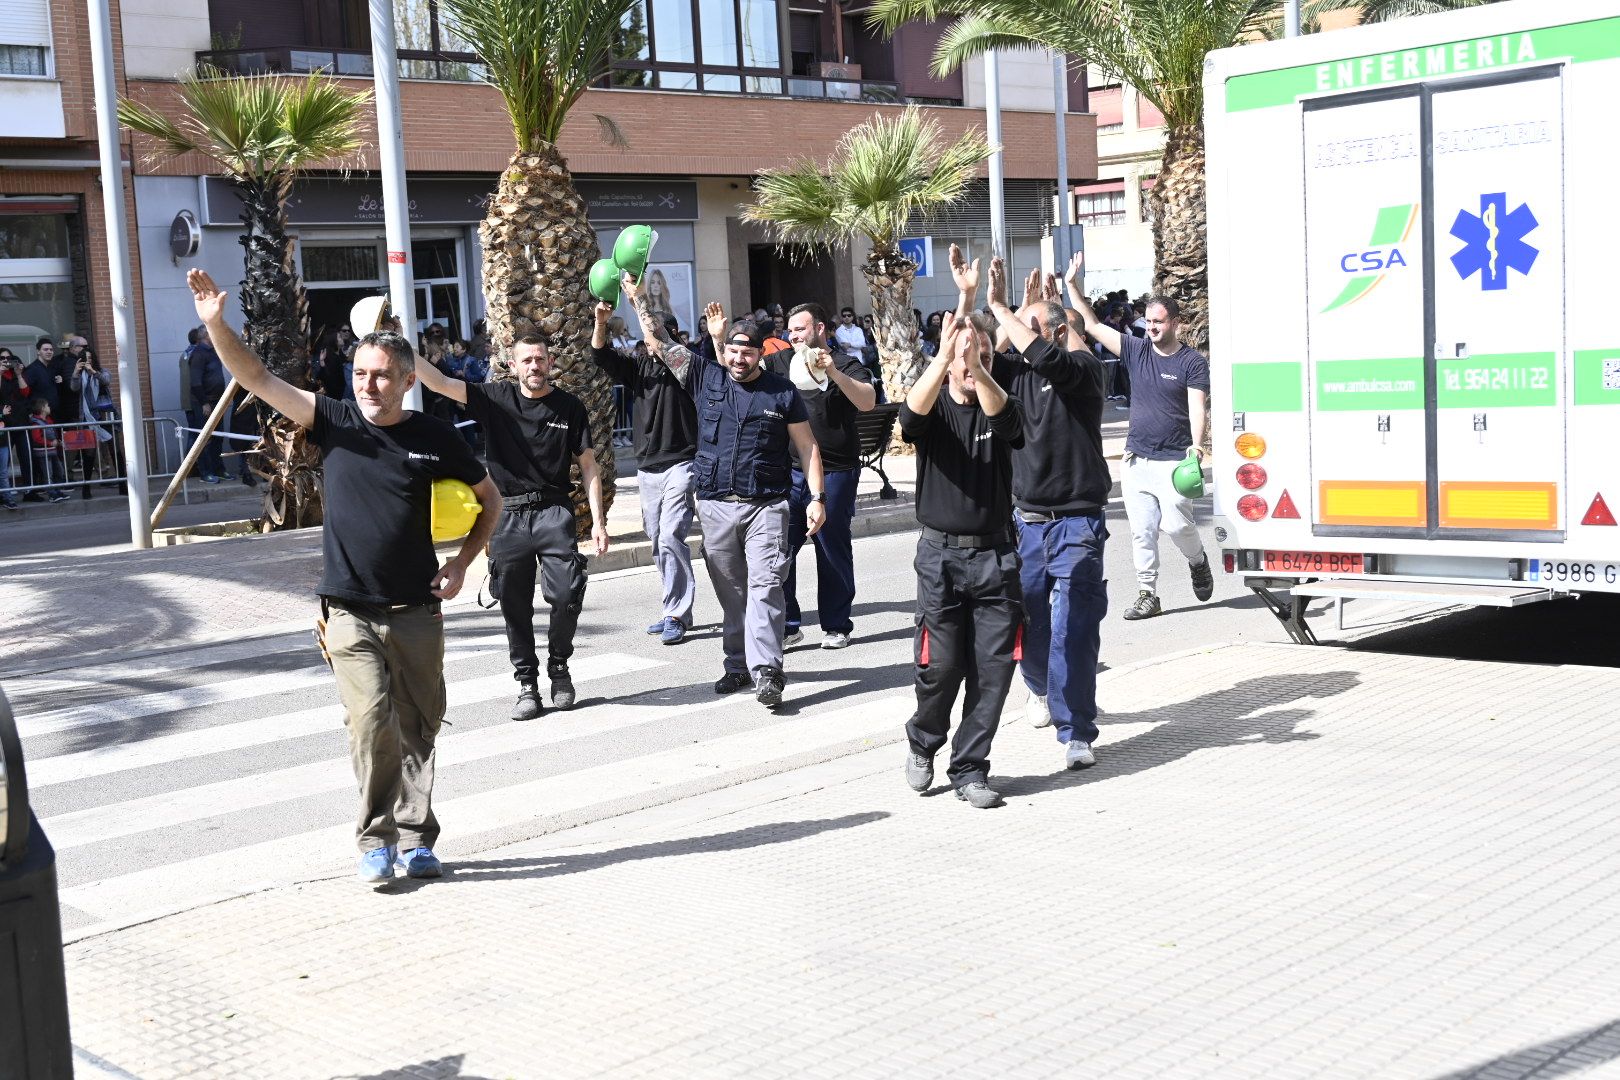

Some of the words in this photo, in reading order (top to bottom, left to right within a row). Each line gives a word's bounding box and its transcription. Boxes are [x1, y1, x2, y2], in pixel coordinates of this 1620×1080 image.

[1315, 32, 1537, 91] ENFERMERIA
[1435, 120, 1553, 155] SANITARIA
[358, 194, 378, 211] Le
[1341, 248, 1407, 273] CSA
[1266, 553, 1276, 570] R
[1282, 553, 1323, 571] 6478
[1330, 555, 1361, 573] BCF
[1543, 561, 1596, 583] 3986
[1605, 564, 1617, 584] G
